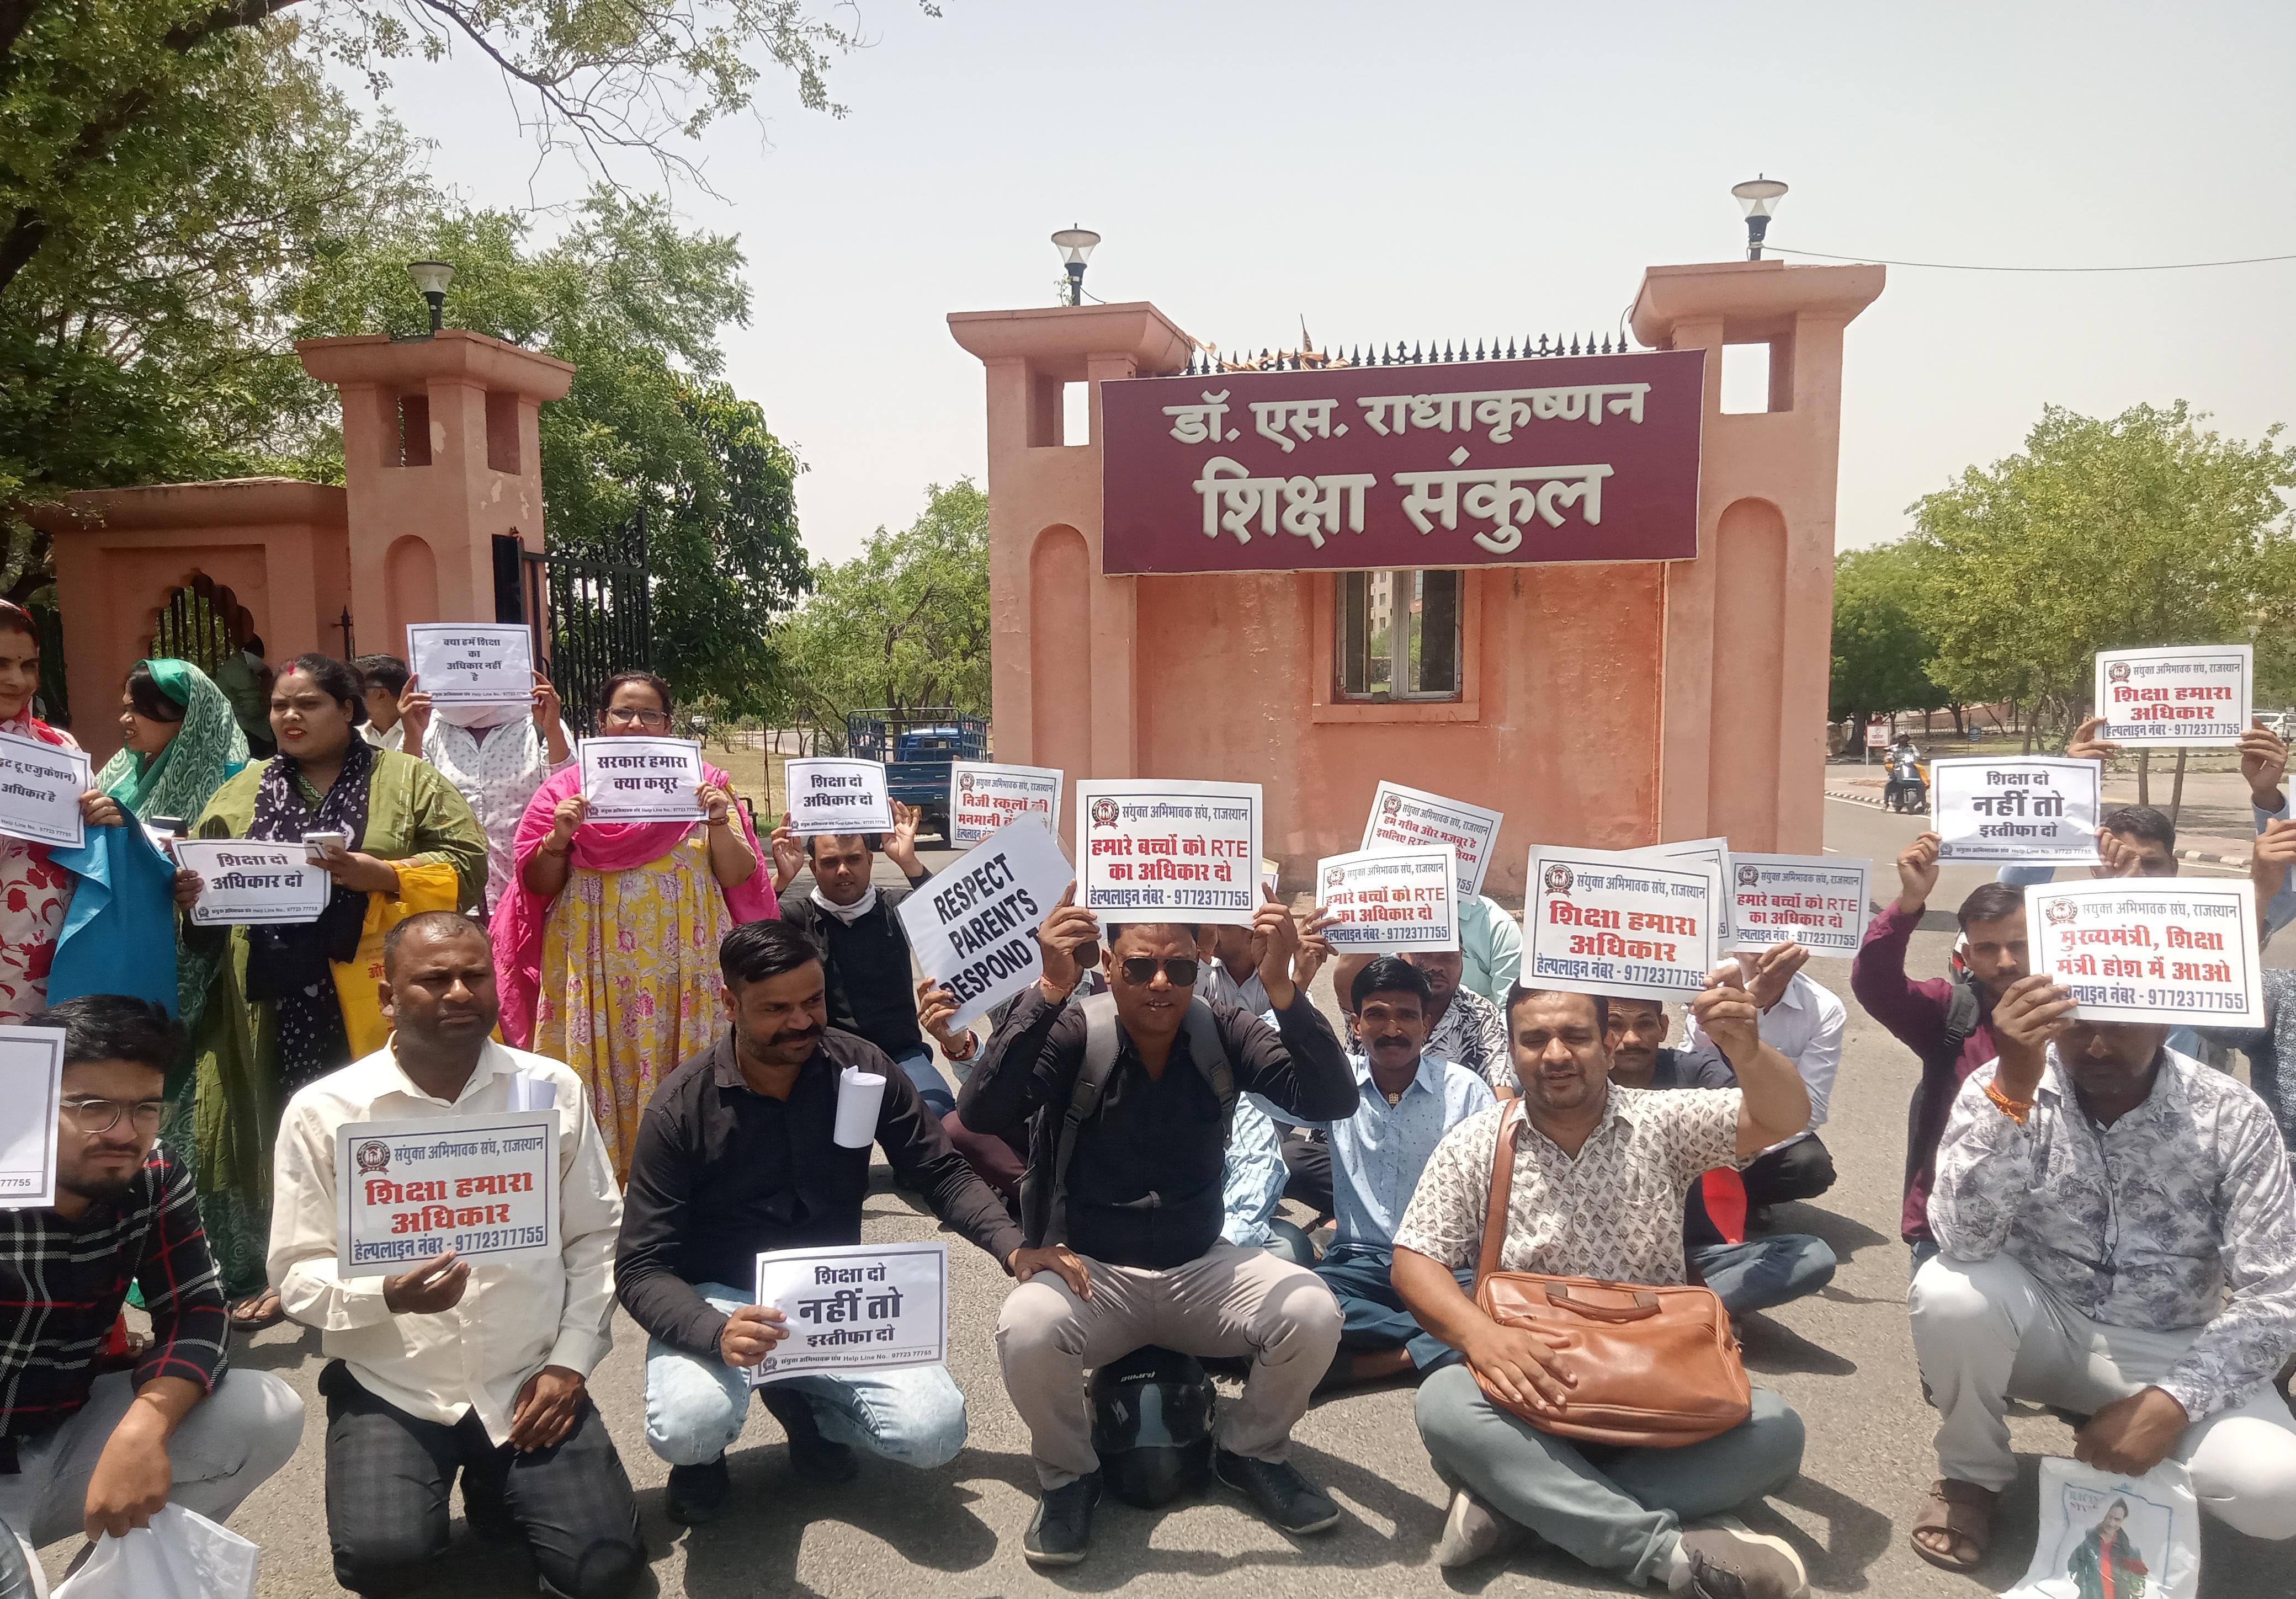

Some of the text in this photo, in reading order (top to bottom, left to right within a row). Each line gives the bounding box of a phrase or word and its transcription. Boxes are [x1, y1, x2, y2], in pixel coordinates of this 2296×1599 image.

[1163, 382, 1651, 453] डॉ. एस. राधाकृष्णन
[1192, 445, 1615, 554] शिक्षा संकुल
[462, 637, 476, 646] हमें
[477, 637, 500, 646] शिक्षा
[447, 660, 502, 670] अधिकार नहीं
[2133, 664, 2154, 677] संयुक्त
[2156, 663, 2192, 674] अभिभावक
[2209, 663, 2240, 673] राजस्थान
[471, 673, 479, 681] है
[2114, 686, 2232, 702] शिक्षा हमारा
[2130, 704, 2215, 721] अधिकार
[2106, 722, 2240, 737] हेल्पलाइन नंबर 9772377755
[597, 756, 687, 768] सरकार हमारा
[613, 777, 678, 793] क्या कसूर
[811, 774, 863, 788] शिक्षा दो
[1986, 771, 2049, 785] शिक्षा दो
[2, 783, 57, 802] अधिकार है
[804, 792, 873, 807] अधिकार दो
[963, 793, 1028, 813] निजी स्कूलों
[1123, 803, 1247, 822] संयुक्त अभिभावक संघ, राजस्थान
[1971, 790, 2065, 817] नहीं तो
[958, 813, 1001, 827] मनमानी
[957, 826, 981, 840] हेल्पलाइन
[1376, 828, 1406, 843] इसलिए
[1399, 820, 1418, 832] गरीब
[1421, 825, 1439, 838] और
[1441, 831, 1468, 849] मजबूर
[1979, 822, 2058, 838] इस्तीफा दो
[1091, 834, 1248, 857] हमारे बच्चों को RTE
[216, 853, 289, 867] शिक्षा दो
[1368, 864, 1399, 876] अभिभावक
[1416, 863, 1444, 873] राजस्थान
[211, 870, 304, 889] अधिकार दो
[1109, 859, 1232, 882] का अधिकार दो
[934, 852, 1015, 926] RESPECT
[1577, 873, 1705, 899] संयुक्त अभिभावक संघ, राजस्थान
[1090, 884, 1249, 908] हेल्पलाइन नंबर 9772377755
[1326, 886, 1445, 907] हमारे बच्चों को RTE
[1737, 892, 1858, 912] हमारे बच्चों को RTE
[1337, 904, 1432, 923] का अधिकार दो
[2117, 899, 2167, 915] अभिभावक
[2193, 903, 2237, 918] राजस्थान
[948, 888, 1039, 960] PARENTS
[1549, 900, 1620, 929] शिक्षा
[1627, 911, 1697, 937] हमारा
[1749, 910, 1843, 928] का अधिकार दो
[1323, 925, 1447, 941] हेल्पलाइन नंबर 9772377755
[1773, 927, 1856, 946] नंबर 9772377755
[2061, 924, 2224, 951] मुख्यमंत्री, शिक्षा
[1569, 932, 1677, 962] अधिकार
[1537, 953, 1705, 986] हेल्पलाइन नंबर 9772377755
[2056, 955, 2232, 982] मंत्री होश में आओ
[2110, 983, 2135, 1004] नंबर
[2149, 989, 2244, 1009] 9772377755
[394, 1137, 544, 1165] संयुक्त अभिभावक संघ, राजस्थान
[365, 1172, 533, 1206] शिक्षा हमारा
[391, 1204, 510, 1234] अधिकार
[354, 1226, 544, 1261] हेल्पलाइन नंबर 9772377755
[815, 1262, 886, 1284] शिक्षा दो
[798, 1286, 903, 1324] नहीं तो
[806, 1324, 895, 1347] इस्तीफा दो
